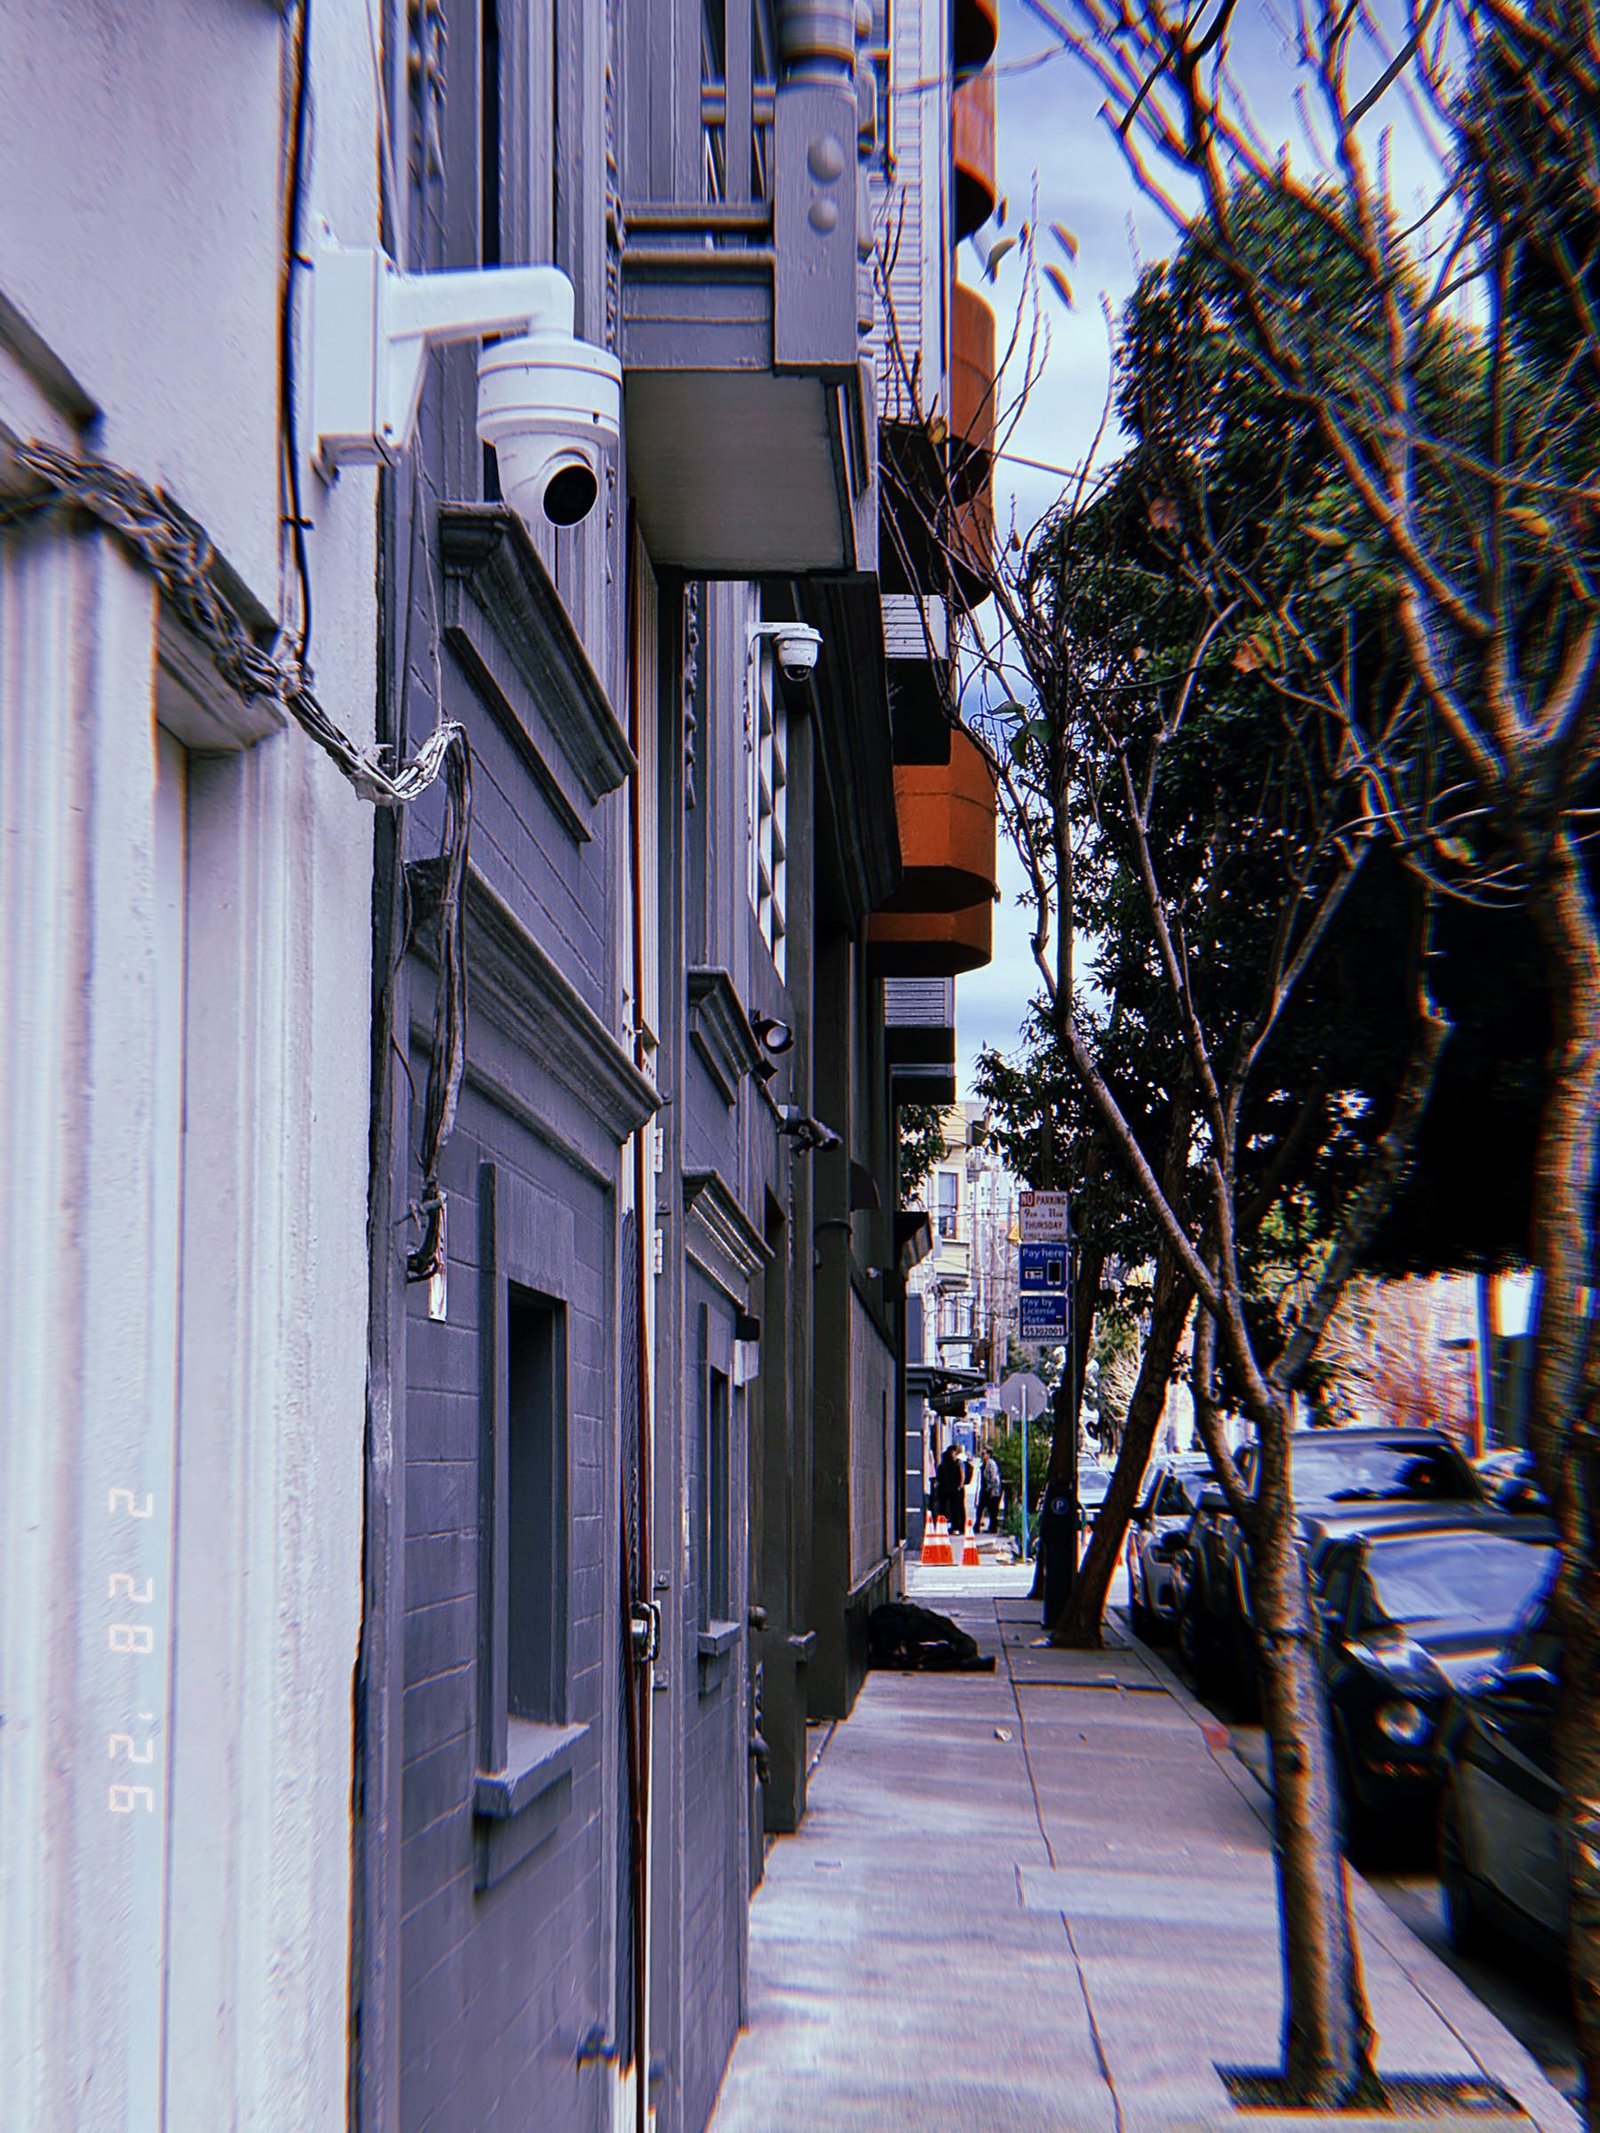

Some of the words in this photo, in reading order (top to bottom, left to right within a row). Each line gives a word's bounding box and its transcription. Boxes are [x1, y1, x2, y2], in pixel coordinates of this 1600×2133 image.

[1021, 1193, 1033, 1206] NO
[1036, 1195, 1066, 1205] PARKING
[1025, 1220, 1063, 1230] THURSDAY
[1022, 1248, 1040, 1260] Pay
[1041, 1248, 1064, 1258] here
[1022, 1298, 1039, 1307] Pay
[1041, 1298, 1053, 1307] by
[1022, 1307, 1056, 1315] License
[1022, 1316, 1046, 1324] Plate
